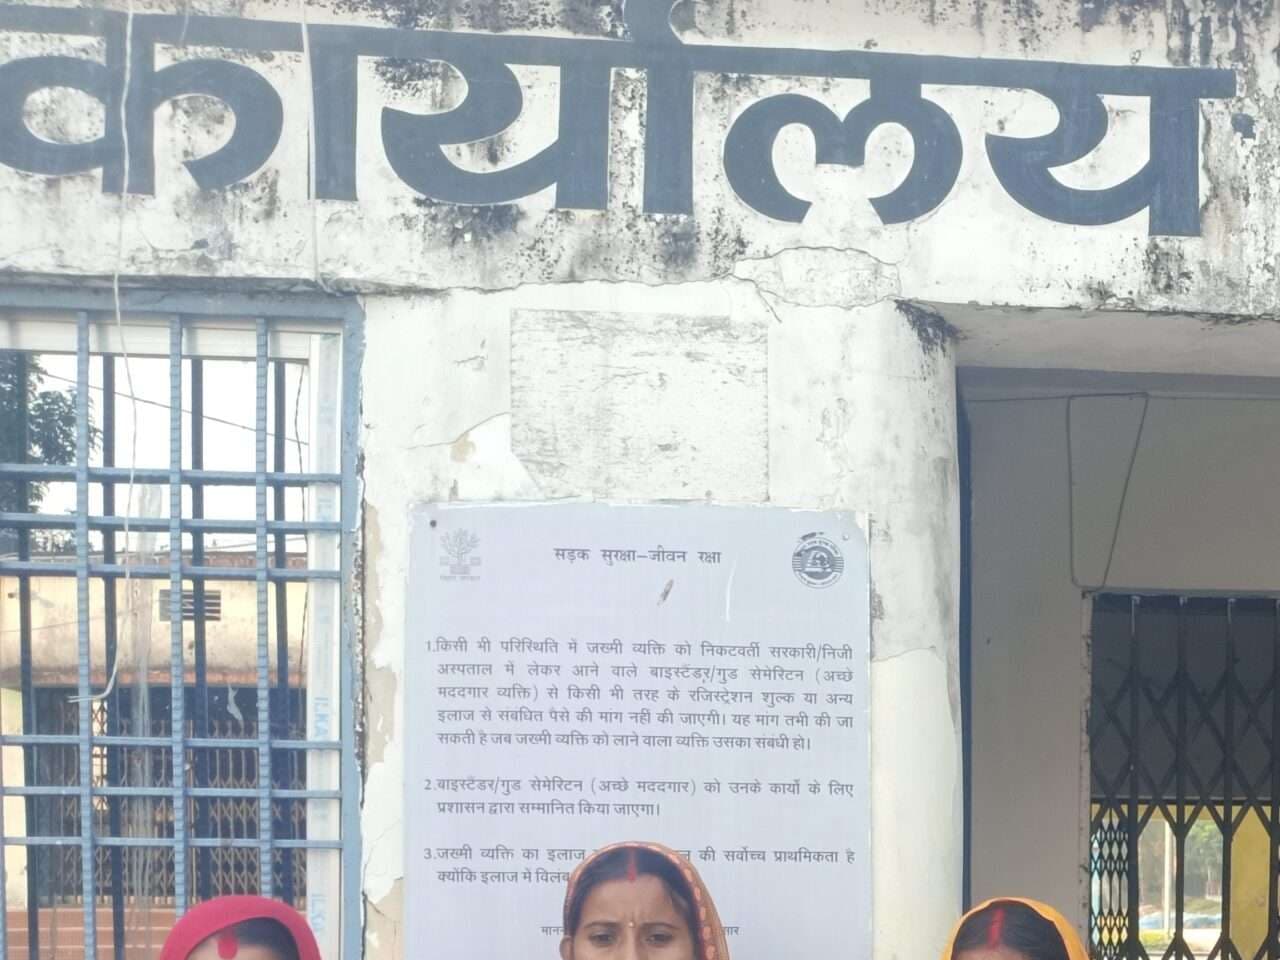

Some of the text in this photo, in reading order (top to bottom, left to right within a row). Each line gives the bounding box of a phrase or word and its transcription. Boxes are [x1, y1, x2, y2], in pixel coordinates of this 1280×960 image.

[0, 0, 1236, 237] कार्यालय
[554, 547, 590, 564] सड़क
[697, 552, 721, 563] रक्षा
[477, 637, 491, 652] भी
[500, 637, 558, 653] परिस्थिति
[568, 639, 577, 653] में
[587, 639, 622, 654] जख्मी
[632, 640, 665, 654] व्यक्ति
[674, 641, 691, 656] को
[700, 641, 760, 657] निकटवर्ती
[438, 664, 492, 675] अस्पताल
[504, 661, 514, 675] में
[528, 662, 560, 675] लेकर
[573, 662, 599, 676] आने
[611, 663, 637, 677] वाले
[438, 687, 488, 698] मददगार
[547, 684, 558, 699] से
[567, 684, 600, 699] किसी
[609, 684, 624, 700] भी
[632, 690, 659, 702] तरह
[667, 686, 680, 701] के
[761, 691, 795, 707] शुल्क
[803, 693, 817, 704] या
[826, 694, 853, 704] अन्य
[437, 710, 474, 722] इलाज
[480, 707, 492, 720] से
[576, 707, 592, 722] की
[598, 709, 623, 723] मांग
[628, 708, 651, 724] नहीं
[656, 708, 673, 724] की
[731, 714, 750, 726] यह
[755, 712, 779, 726] मांग
[784, 711, 808, 726] तभी
[814, 712, 831, 727] की
[836, 717, 853, 728] जा
[437, 729, 475, 744] सकती
[479, 733, 487, 745] है
[490, 733, 512, 744] जब
[515, 729, 552, 744] जख्मी
[555, 730, 589, 745] व्यक्ति
[592, 731, 608, 745] को
[612, 732, 639, 746] लाने
[642, 736, 672, 746] वाला
[675, 732, 709, 747] व्यक्ति
[712, 737, 751, 748] उसका
[704, 778, 720, 793] को
[728, 779, 761, 793] उनके
[768, 779, 800, 794] कार्यों
[808, 780, 820, 794] के
[828, 780, 853, 797] लिए
[437, 802, 485, 813] प्रशासन
[488, 803, 514, 814] द्वारा
[518, 799, 575, 814] सम्मानित
[578, 799, 610, 814] किया
[480, 844, 514, 859] व्यक्ति
[521, 849, 539, 860] का
[547, 849, 586, 862] इलाज
[698, 846, 715, 861] की
[723, 847, 766, 861] सर्वोच्च
[774, 847, 838, 862] प्राथमिकता
[846, 848, 855, 864] है
[437, 867, 476, 882] क्योंकि
[480, 872, 518, 884] इलाज
[522, 868, 531, 882] में
